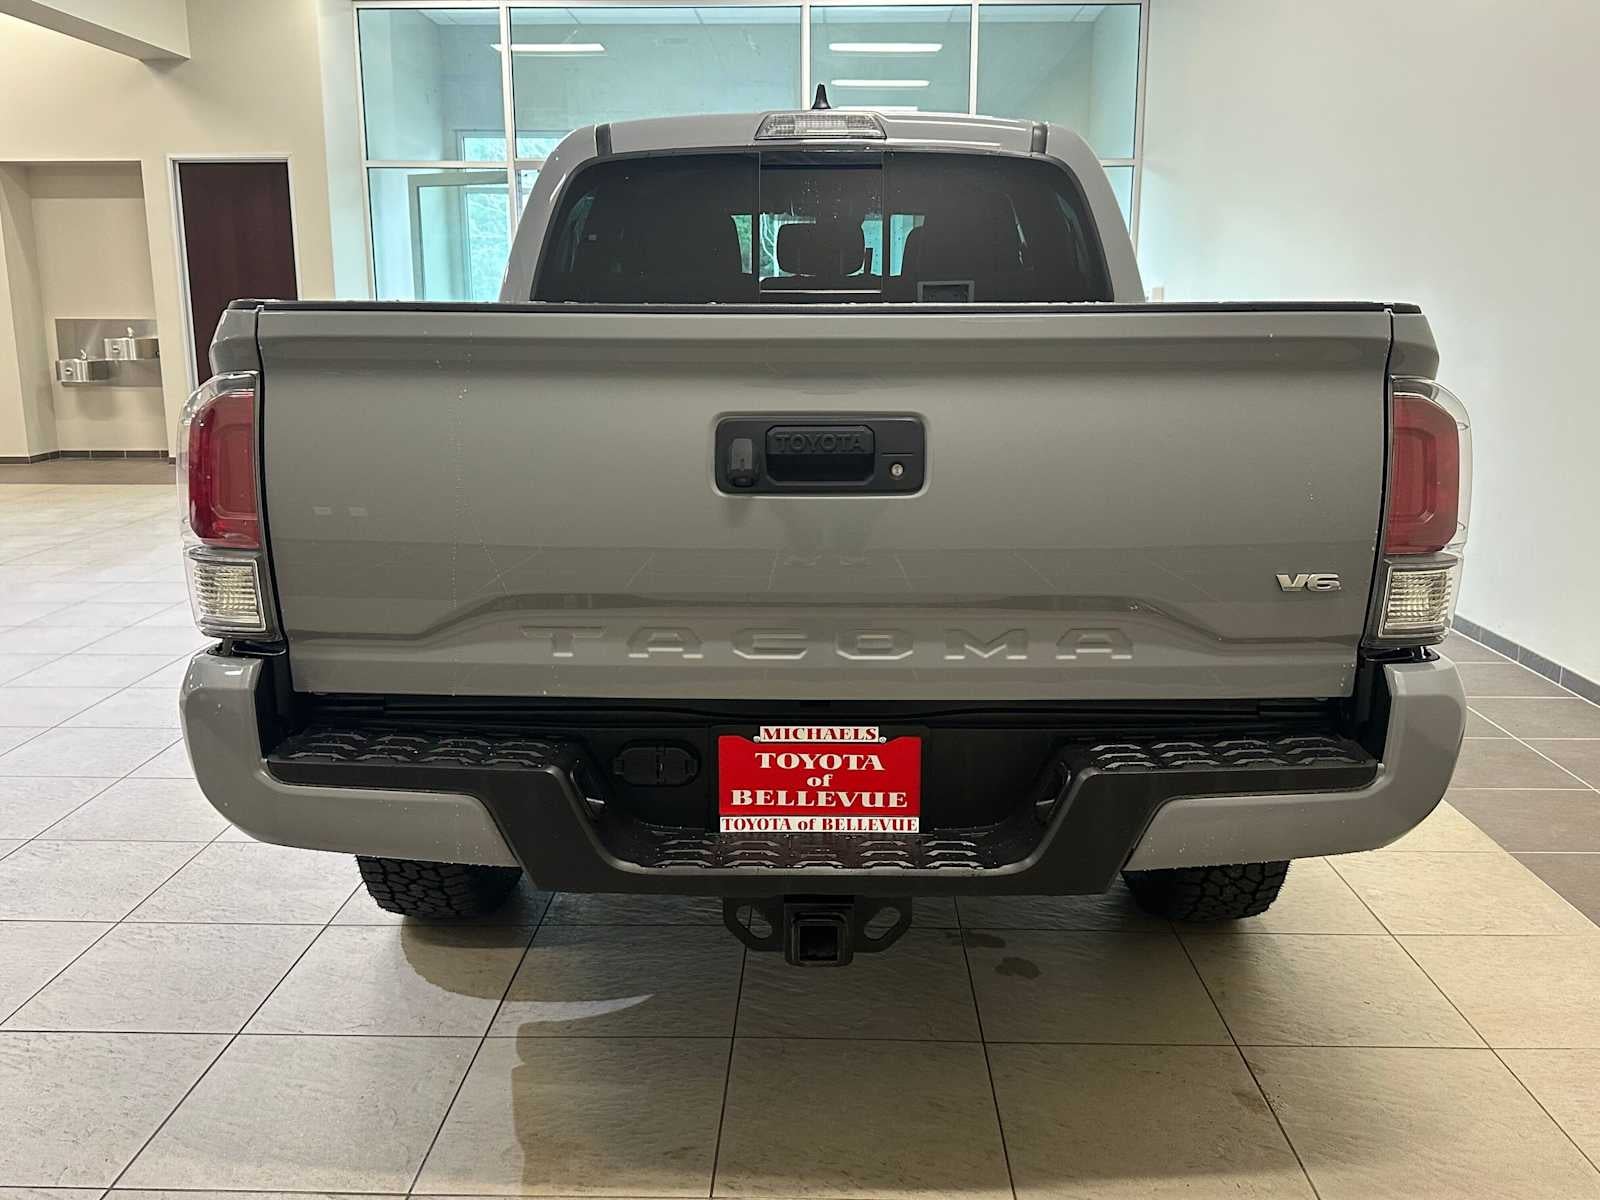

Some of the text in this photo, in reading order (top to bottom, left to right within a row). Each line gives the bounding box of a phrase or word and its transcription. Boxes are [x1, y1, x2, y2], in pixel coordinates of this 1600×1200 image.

[774, 433, 863, 451] TOYOTA
[1276, 573, 1341, 592] V6
[520, 624, 1135, 660] TACOMA
[763, 727, 878, 741] MICHAELS
[754, 752, 886, 771] TOYOTA
[806, 774, 834, 787] of
[730, 789, 908, 808] BELLEVUE
[721, 818, 918, 832] TOYOTA of BELLEVUE
